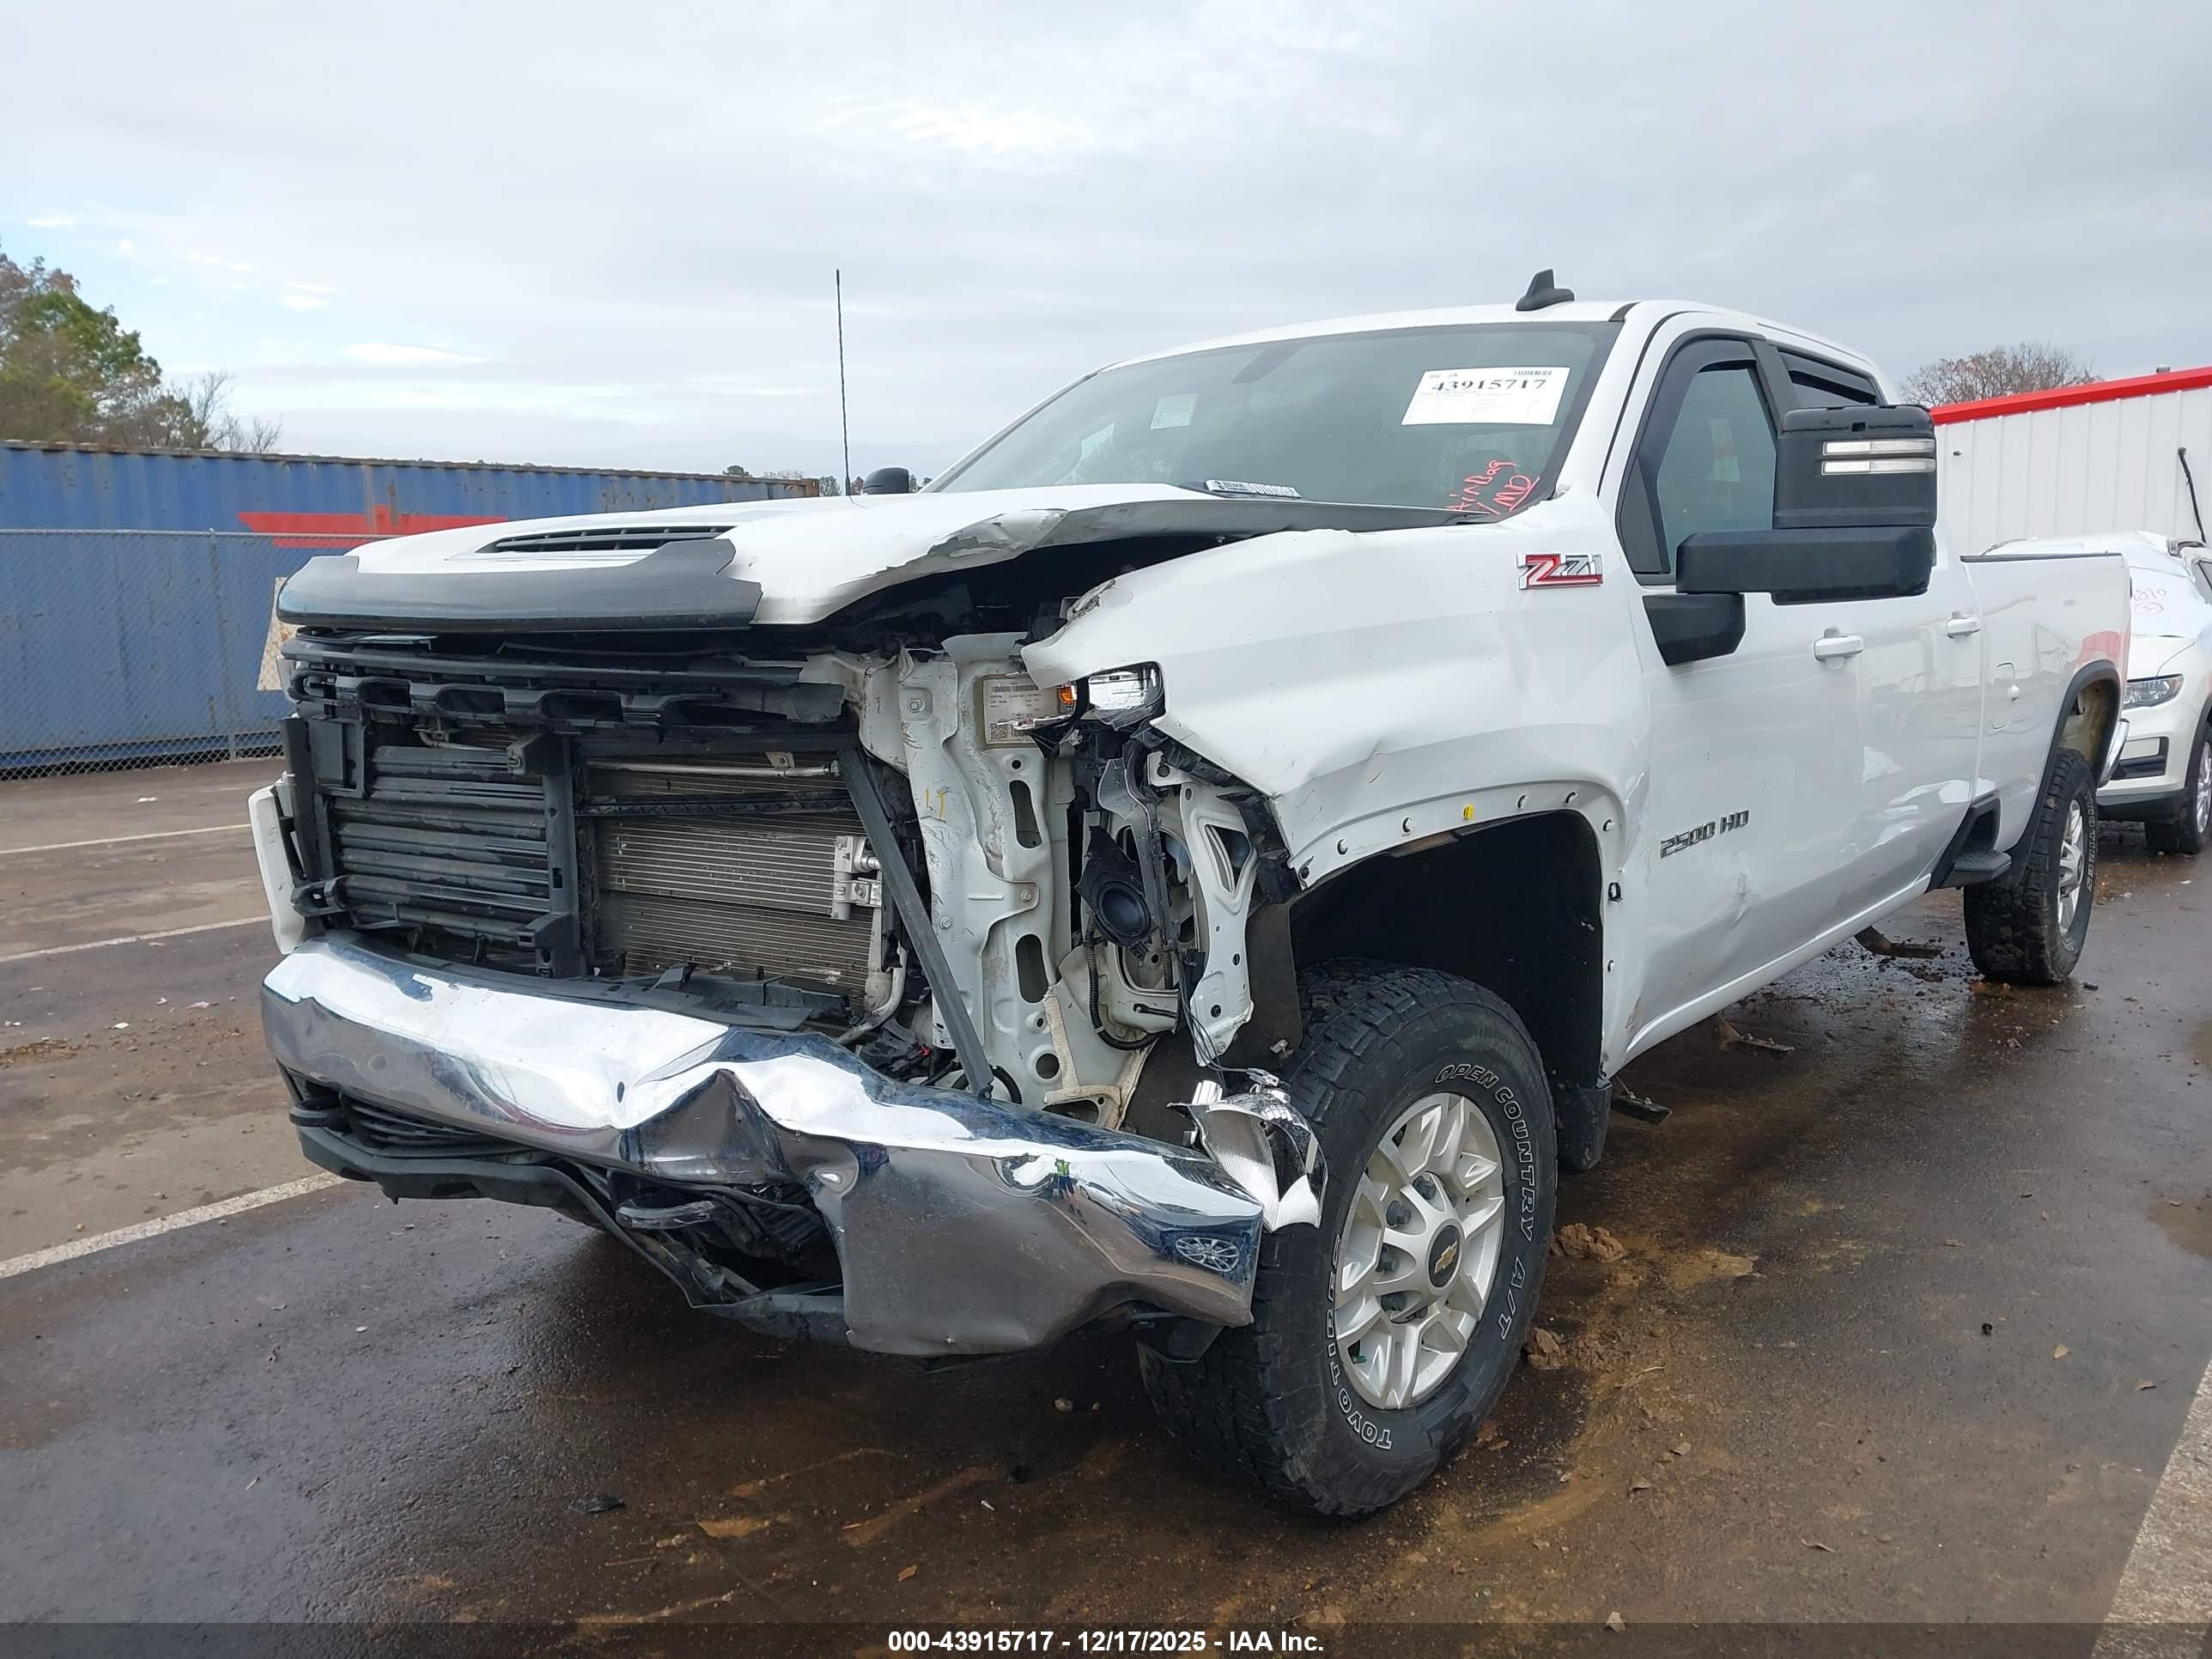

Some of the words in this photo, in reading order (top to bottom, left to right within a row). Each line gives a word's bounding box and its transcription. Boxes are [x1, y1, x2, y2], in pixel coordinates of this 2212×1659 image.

[1431, 379, 1547, 392] 43915717
[1660, 821, 1716, 859] 2500
[1720, 810, 1749, 834] HD
[1434, 1063, 1499, 1090] OPEN
[1494, 1086, 1537, 1243] COUNTRY
[1326, 1234, 1342, 1386] TIRES
[1497, 1255, 1528, 1341] A/T
[1338, 1388, 1393, 1450] TOYO
